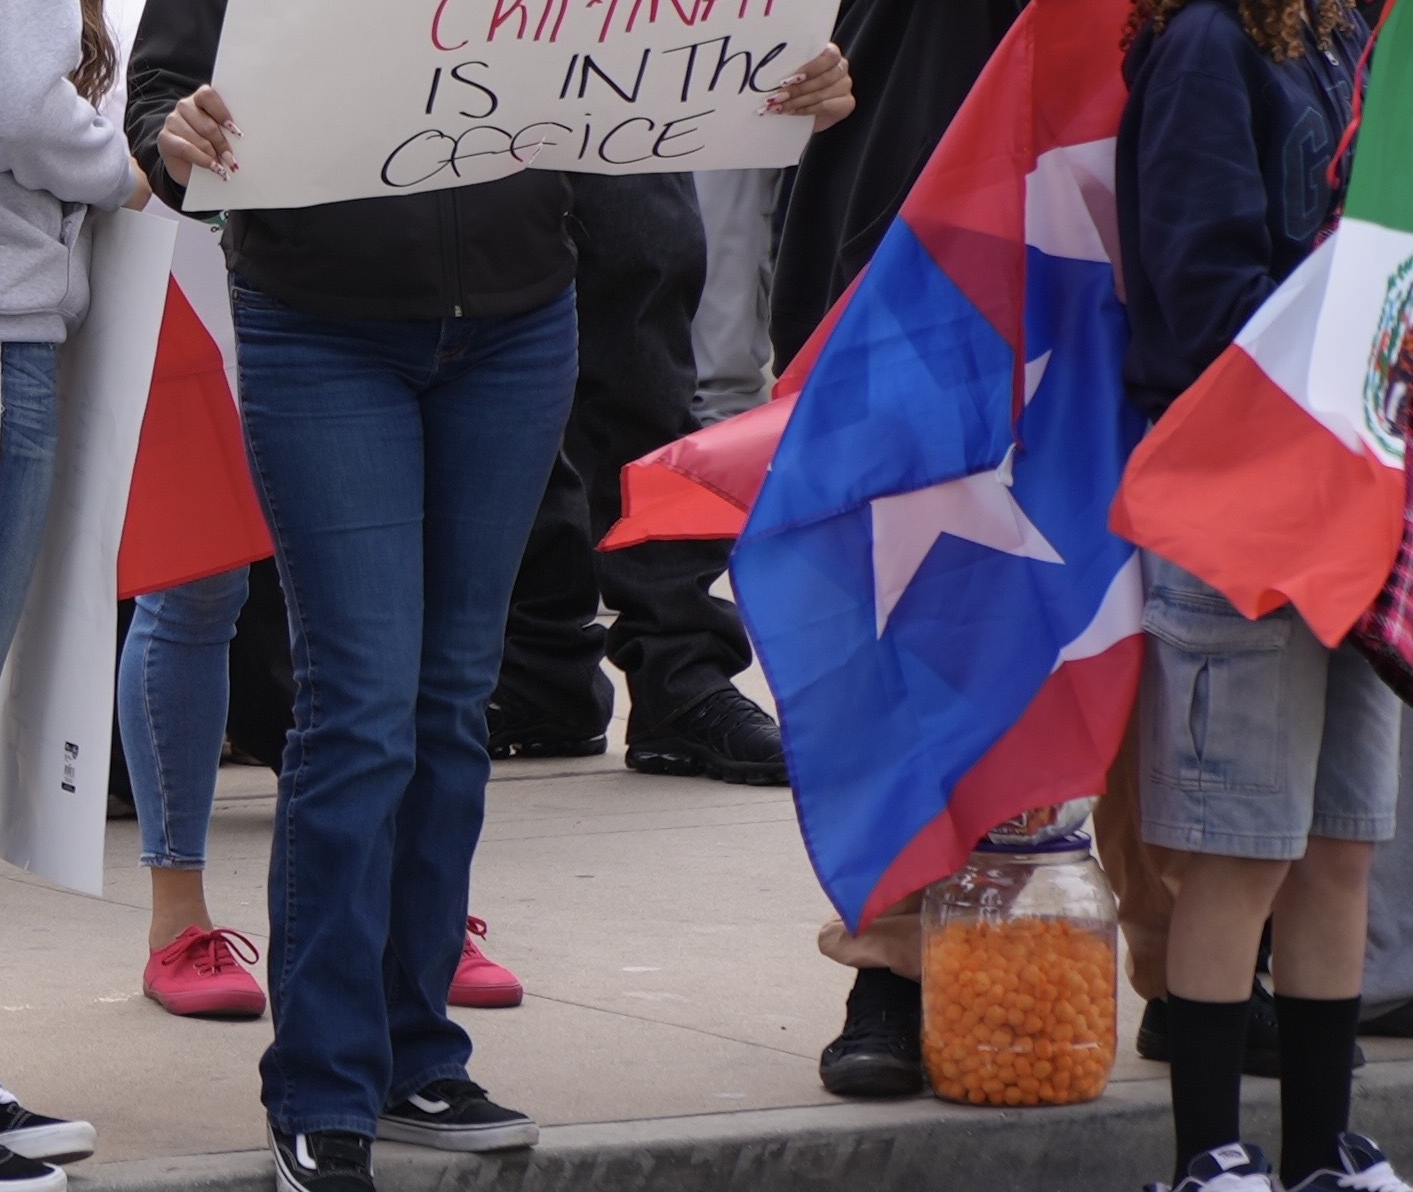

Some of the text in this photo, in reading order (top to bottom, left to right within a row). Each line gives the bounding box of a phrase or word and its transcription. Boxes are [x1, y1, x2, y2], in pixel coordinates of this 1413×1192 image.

[425, 35, 789, 119] IS IN The
